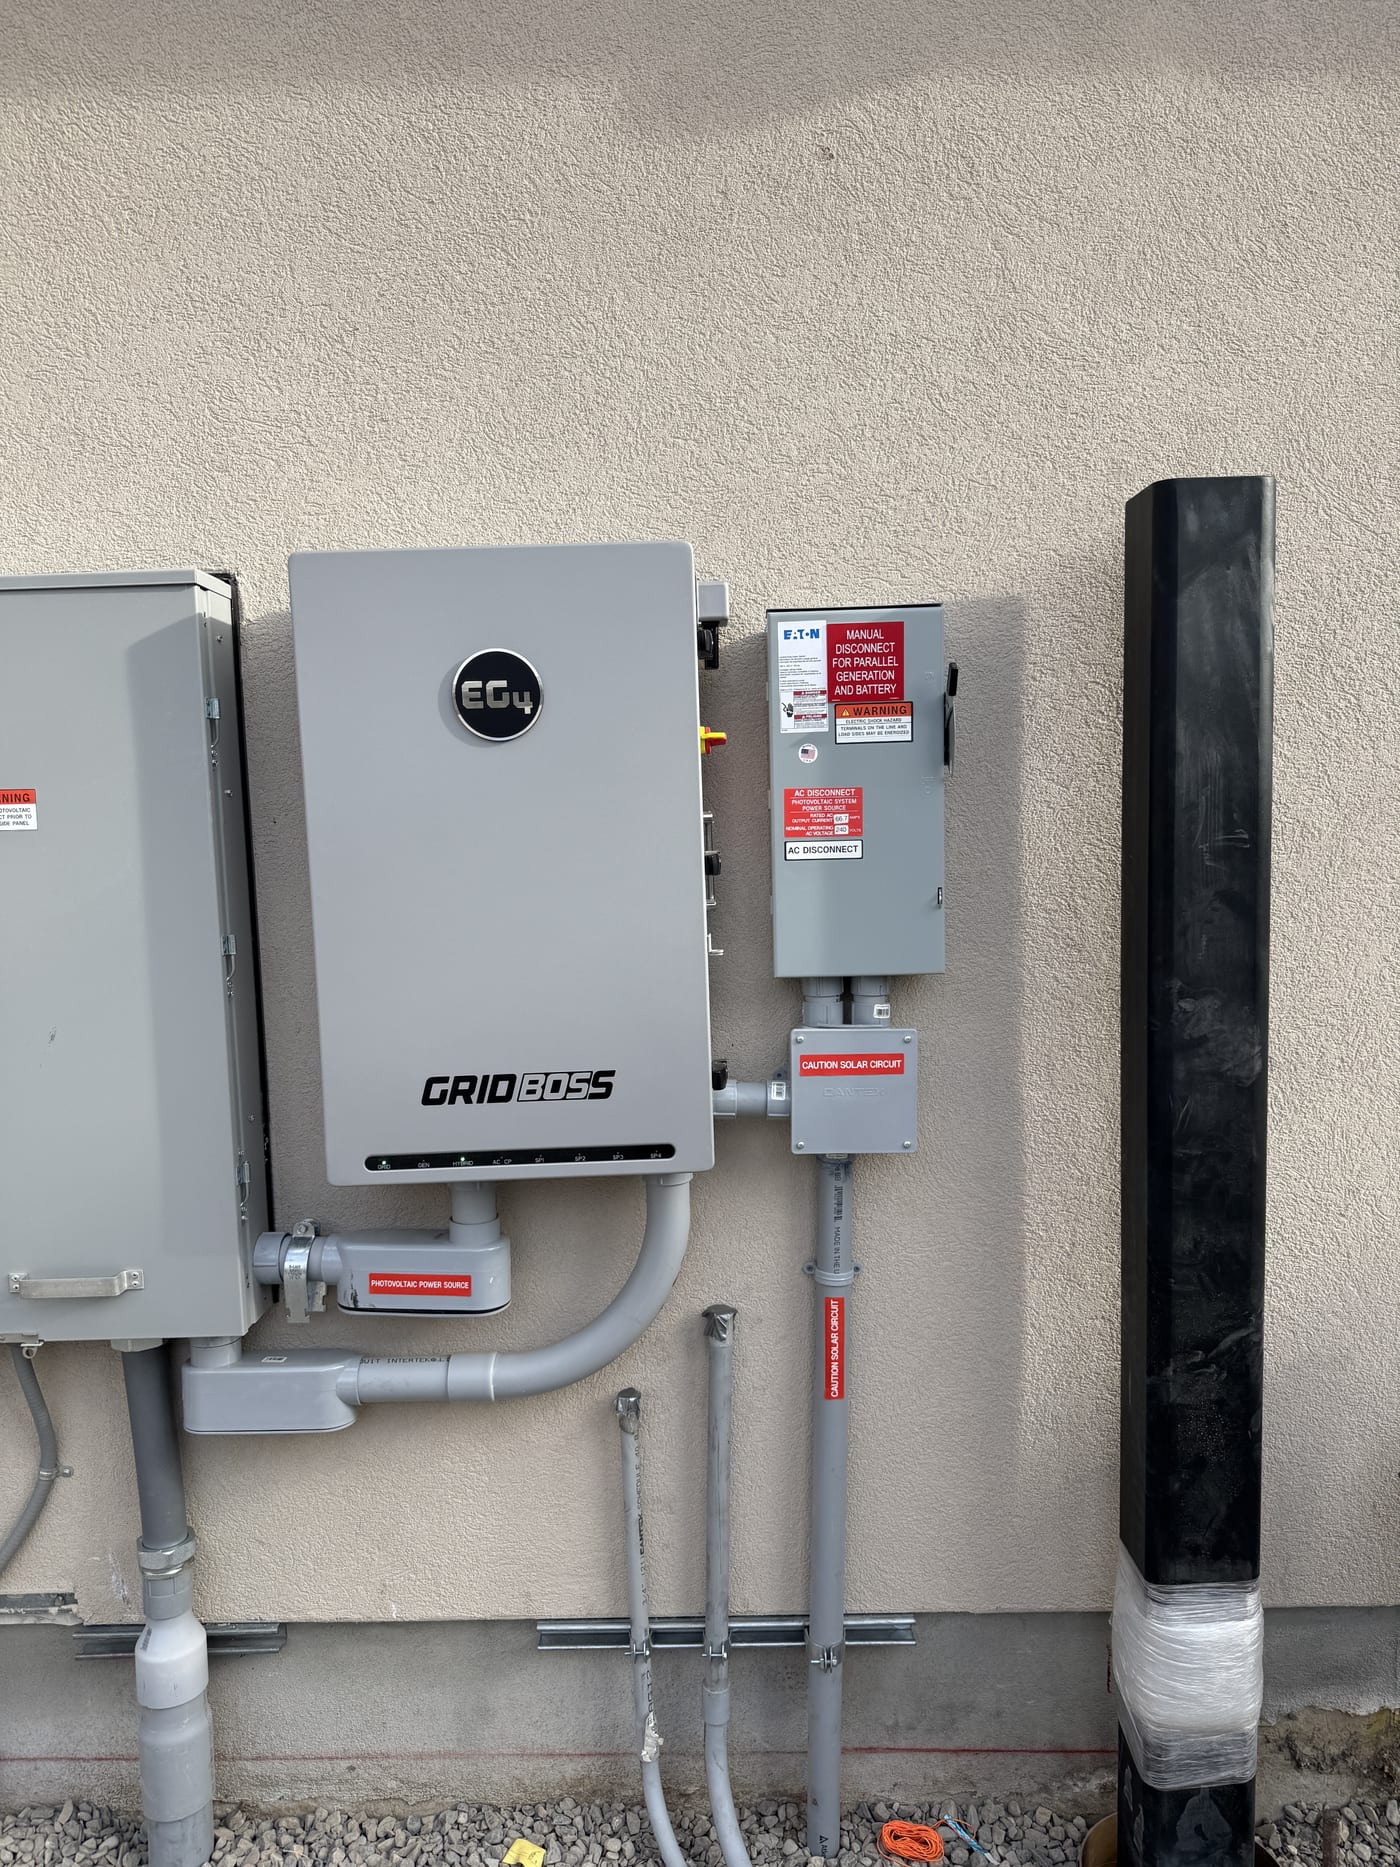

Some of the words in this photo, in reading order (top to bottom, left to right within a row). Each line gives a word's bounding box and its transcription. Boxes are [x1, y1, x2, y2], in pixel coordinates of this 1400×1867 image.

[783, 628, 820, 640] EATON
[846, 629, 884, 640] MANUAL
[835, 642, 895, 654] DISCONNECT
[832, 657, 852, 668] FOR
[854, 656, 899, 667] PARALLEL
[836, 670, 895, 681] GENERATION
[834, 685, 854, 696] AND
[856, 684, 896, 695] BATTERY
[461, 680, 533, 714] EG4
[853, 705, 907, 716] WARNING
[0, 793, 30, 803] NING
[803, 845, 858, 854] DISCONNECT
[802, 1061, 838, 1070] CAUTION
[840, 1060, 868, 1069] SOLAR
[869, 1060, 902, 1068] CIRCUIT
[371, 1279, 418, 1288] PHOTOVOLTAIC
[419, 1280, 442, 1289] POWER
[443, 1281, 469, 1289] SOURCE
[831, 1299, 839, 1332] CIRCUIT
[831, 1332, 839, 1361] SOLAR
[831, 1362, 839, 1398] CAUTION
